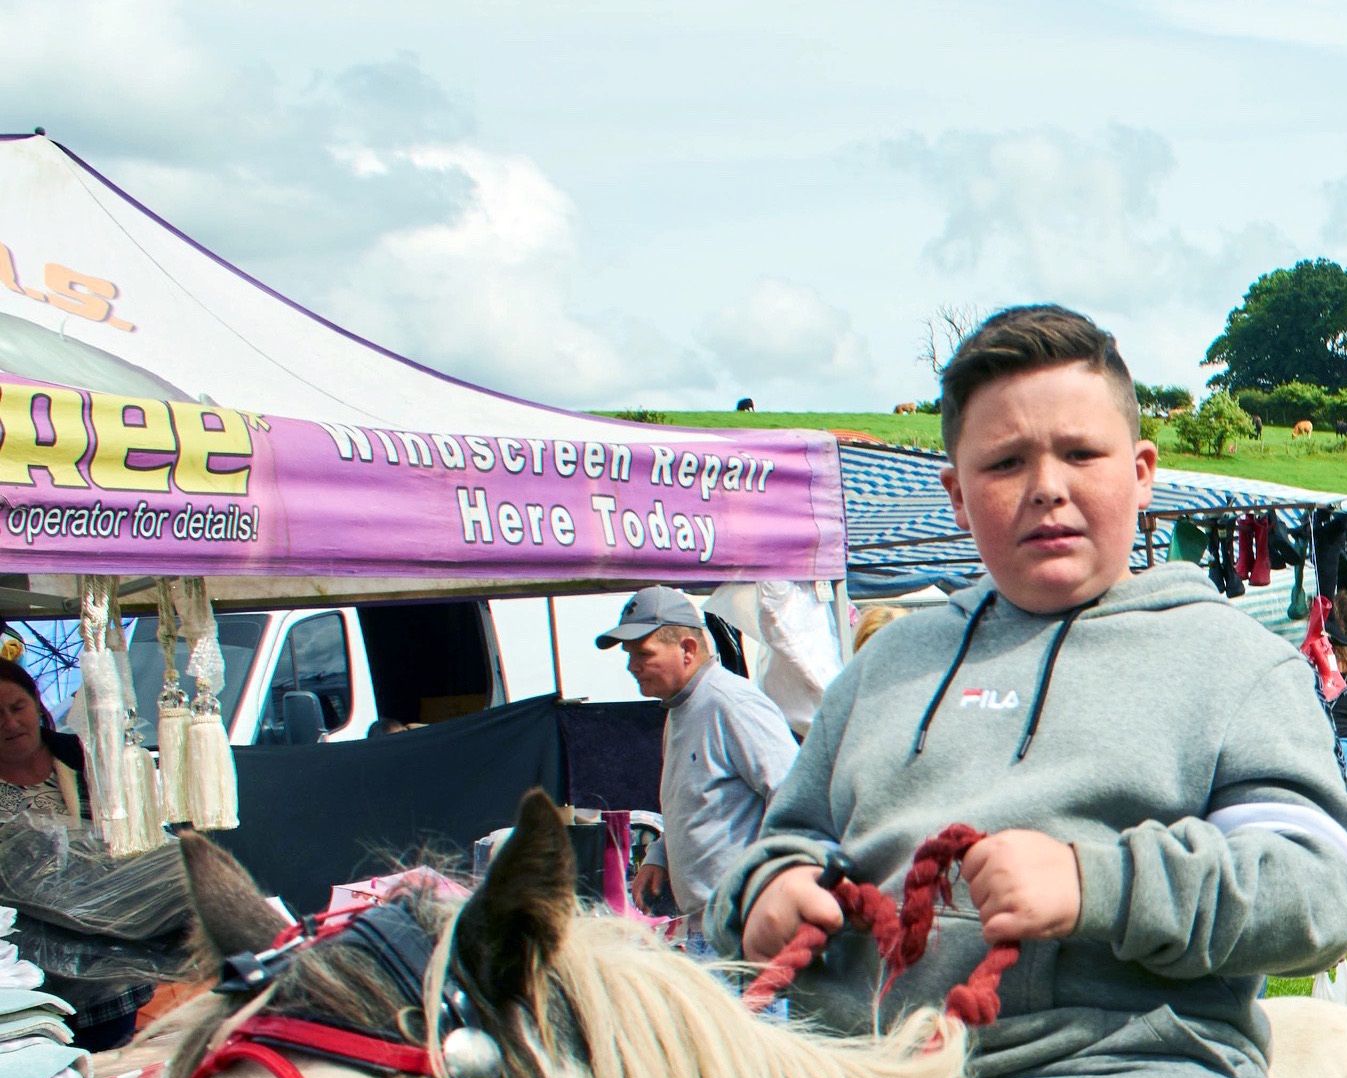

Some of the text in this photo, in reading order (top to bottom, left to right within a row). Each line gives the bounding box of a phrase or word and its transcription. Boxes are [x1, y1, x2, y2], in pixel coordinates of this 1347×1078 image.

[650, 444, 775, 501] Repair
[7, 499, 260, 545] operator for details!
[456, 486, 716, 563] Here Today
[960, 688, 1020, 710] FILA
